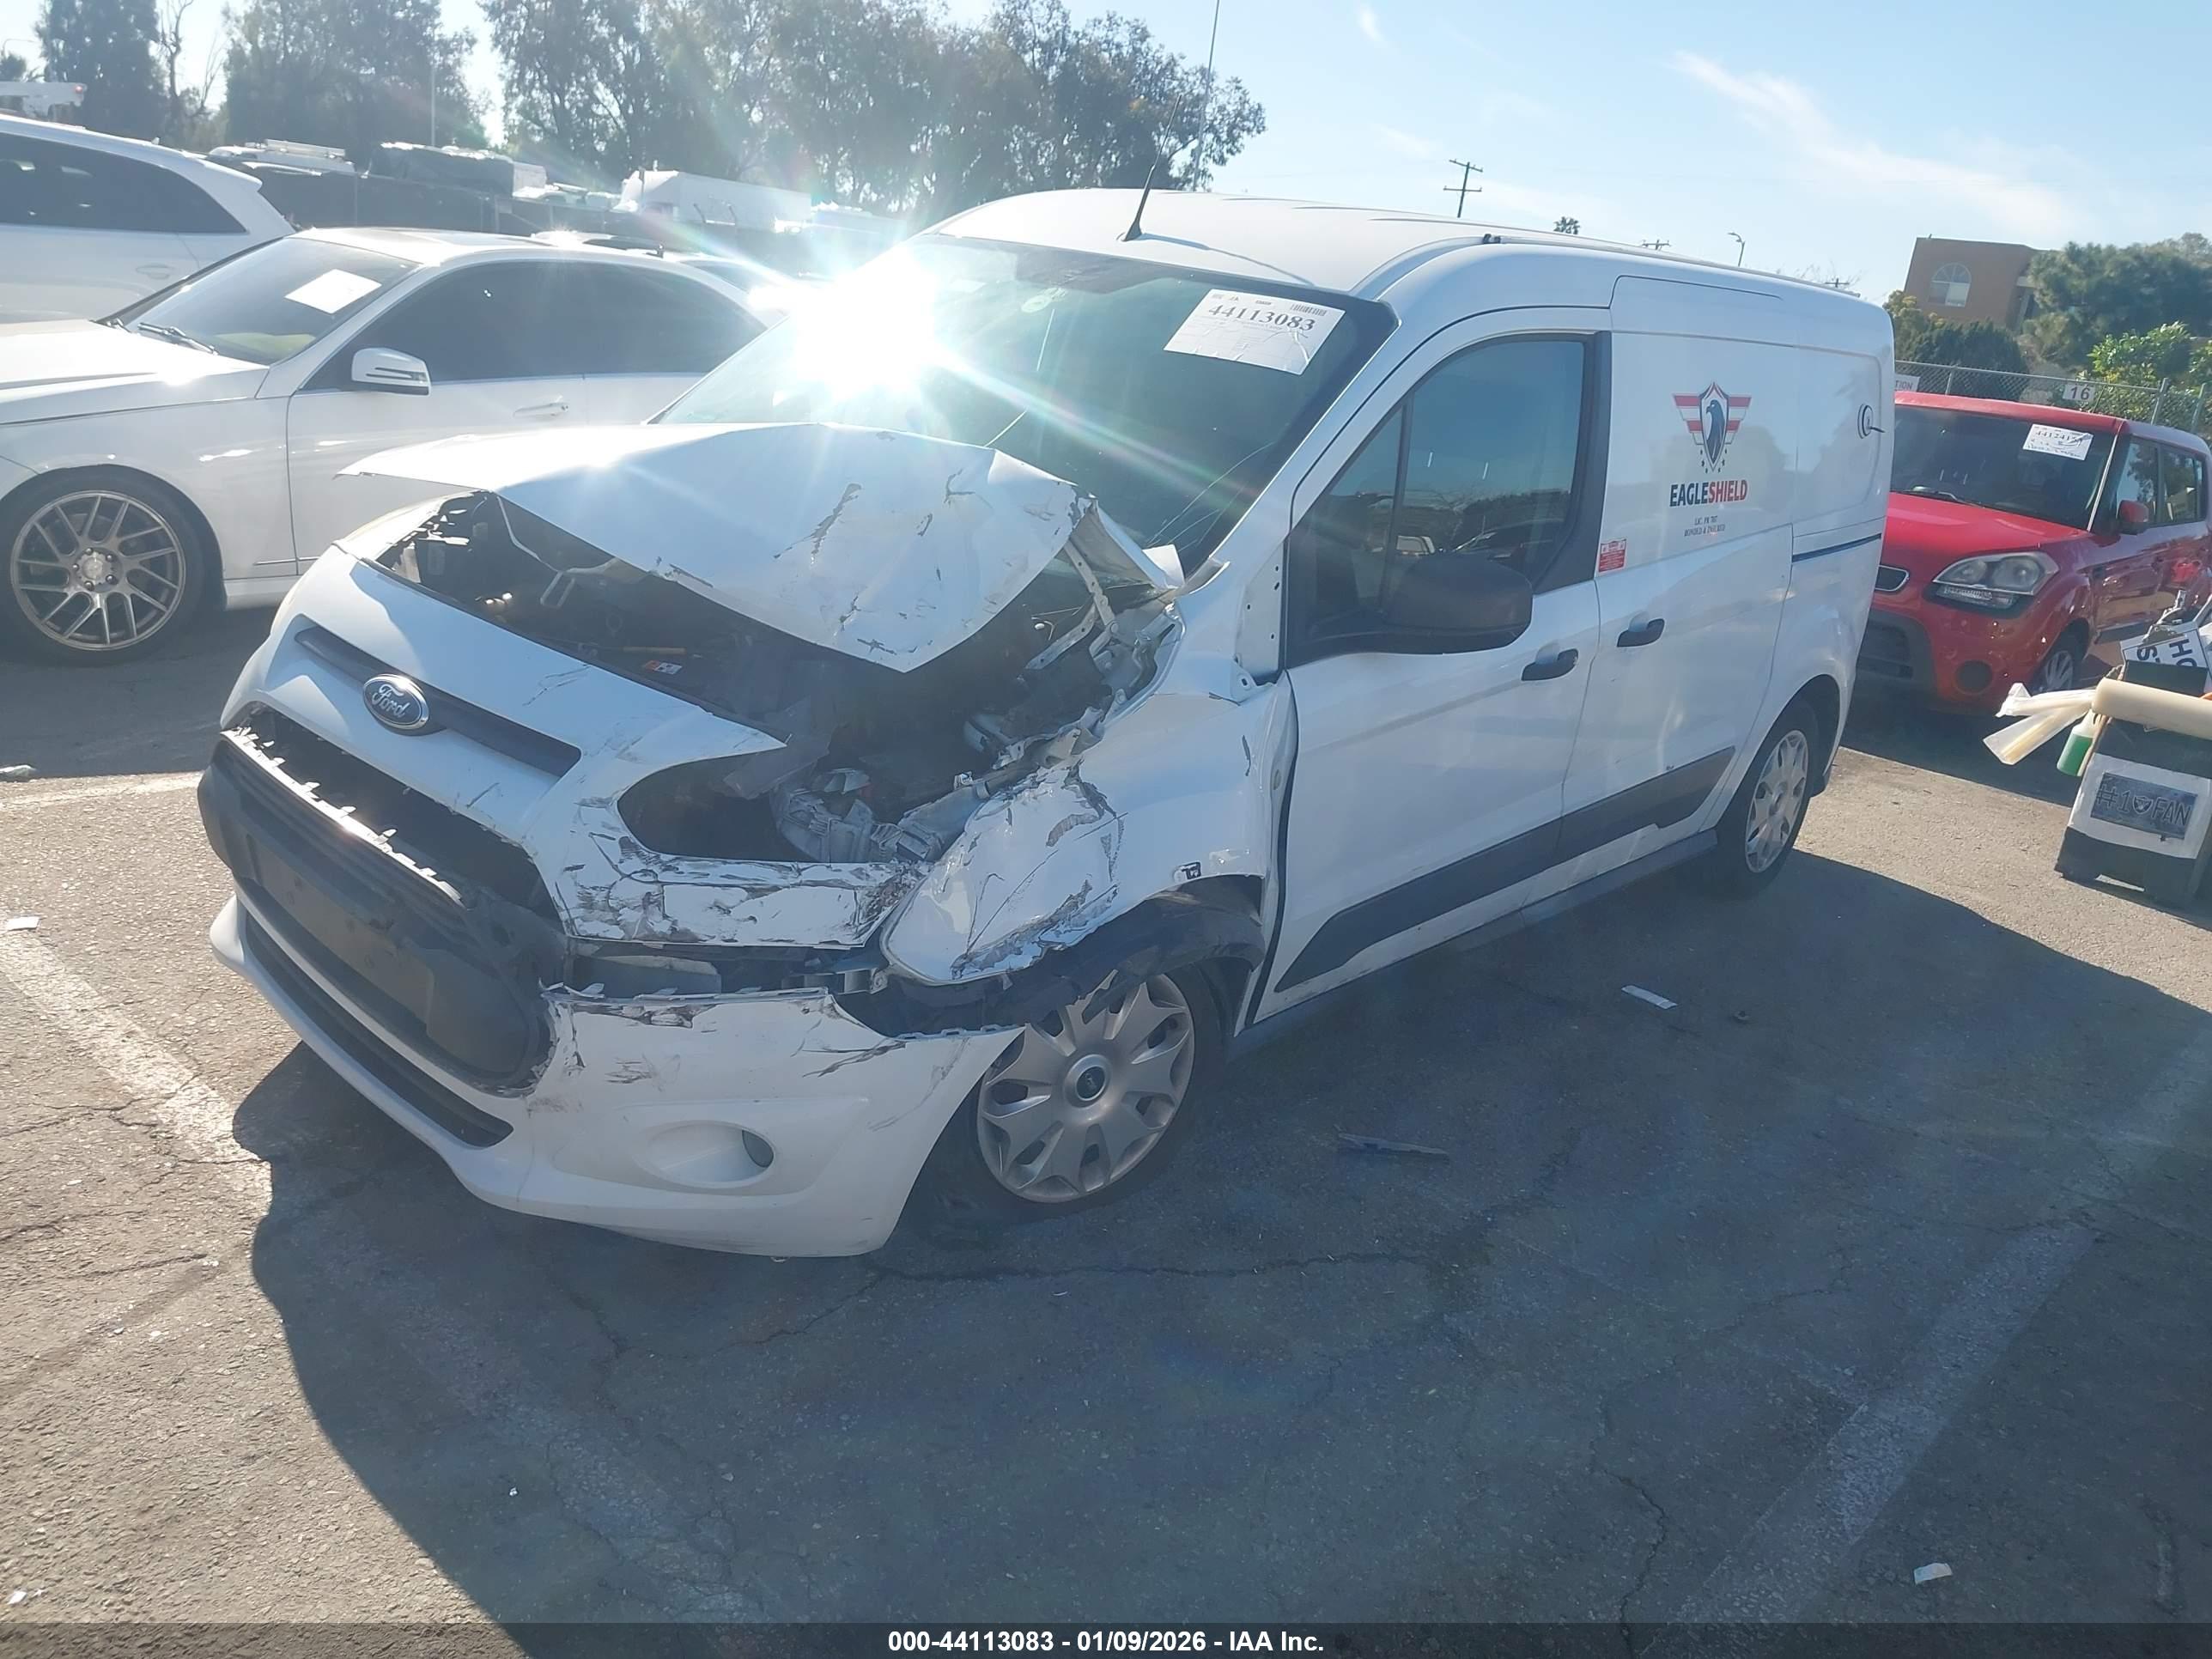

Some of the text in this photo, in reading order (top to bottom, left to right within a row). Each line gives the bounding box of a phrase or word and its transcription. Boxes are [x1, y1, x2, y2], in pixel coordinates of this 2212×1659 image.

[1208, 304, 1316, 331] 44113083
[2070, 386, 2091, 400] 16
[1669, 479, 1747, 507] EAGLESHIELD
[372, 684, 410, 718] Ford
[2151, 796, 2192, 827] FAN
